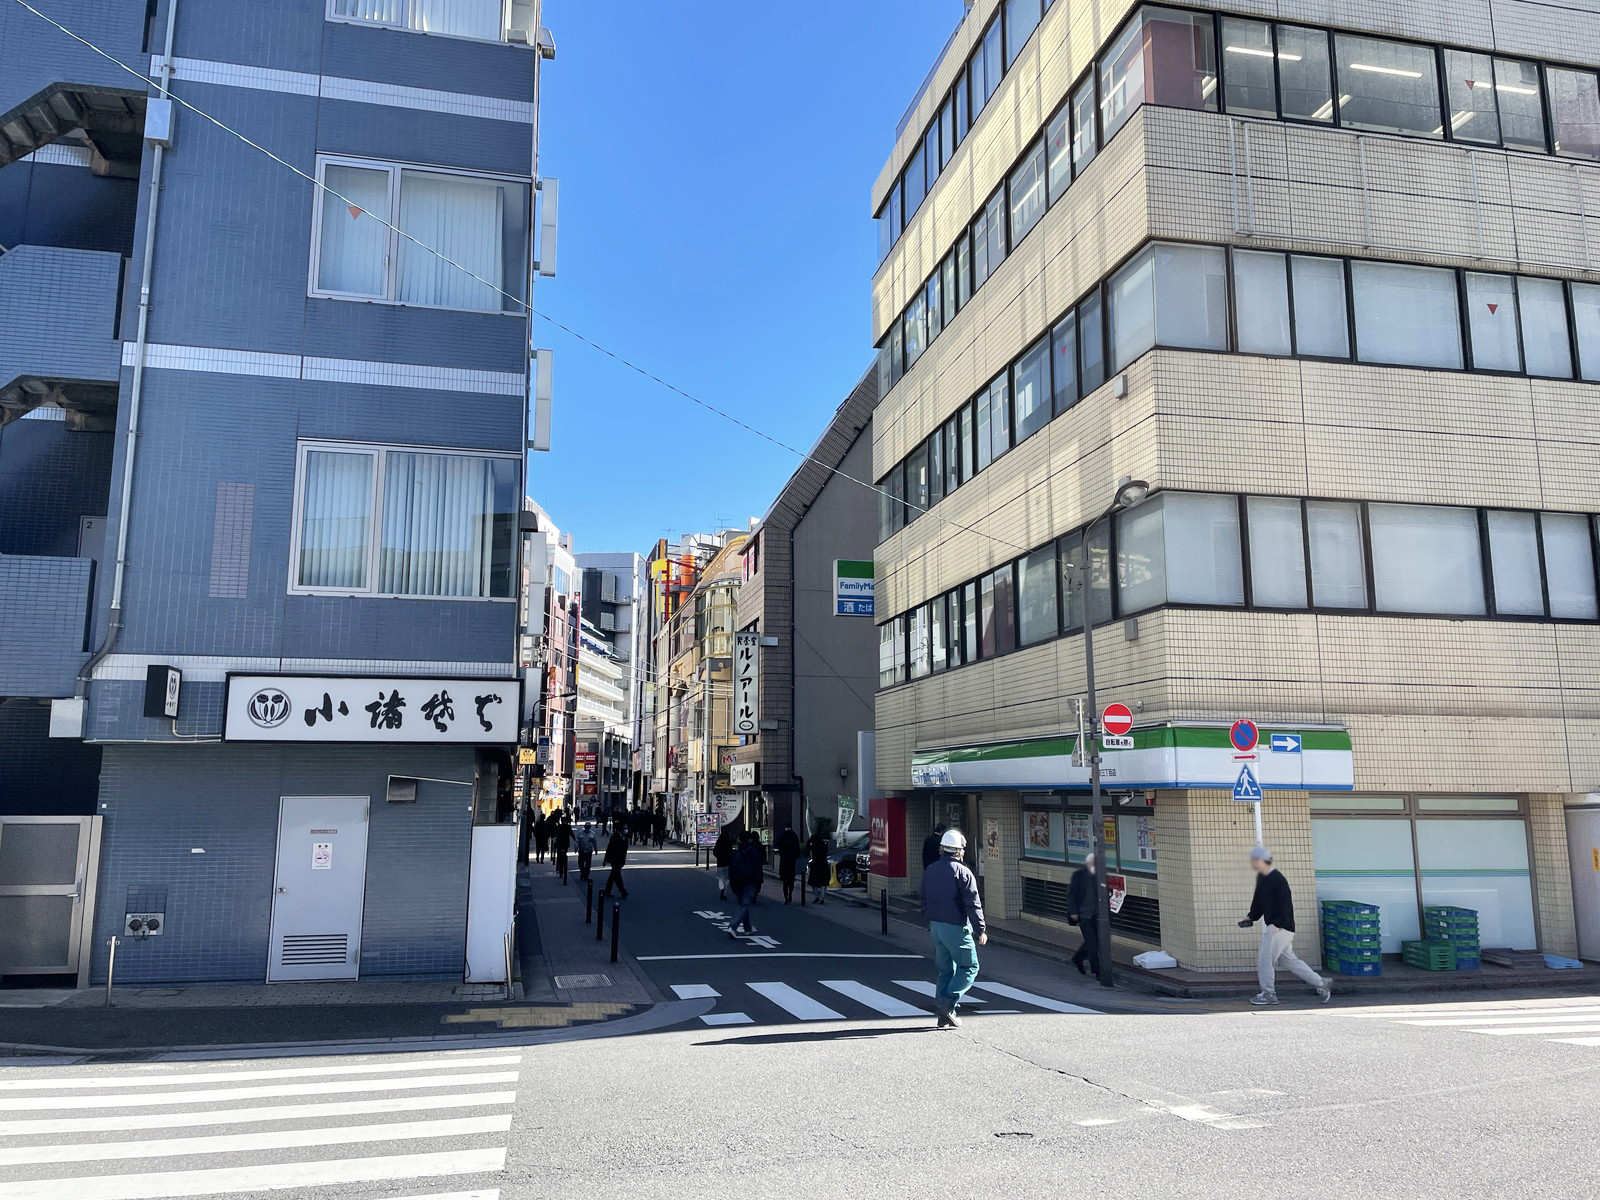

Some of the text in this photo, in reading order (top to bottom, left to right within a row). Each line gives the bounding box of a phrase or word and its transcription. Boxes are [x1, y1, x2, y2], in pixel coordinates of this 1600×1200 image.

[86, 521, 93, 529] 2
[843, 601, 855, 613] 酒
[739, 647, 754, 719] ルノアール
